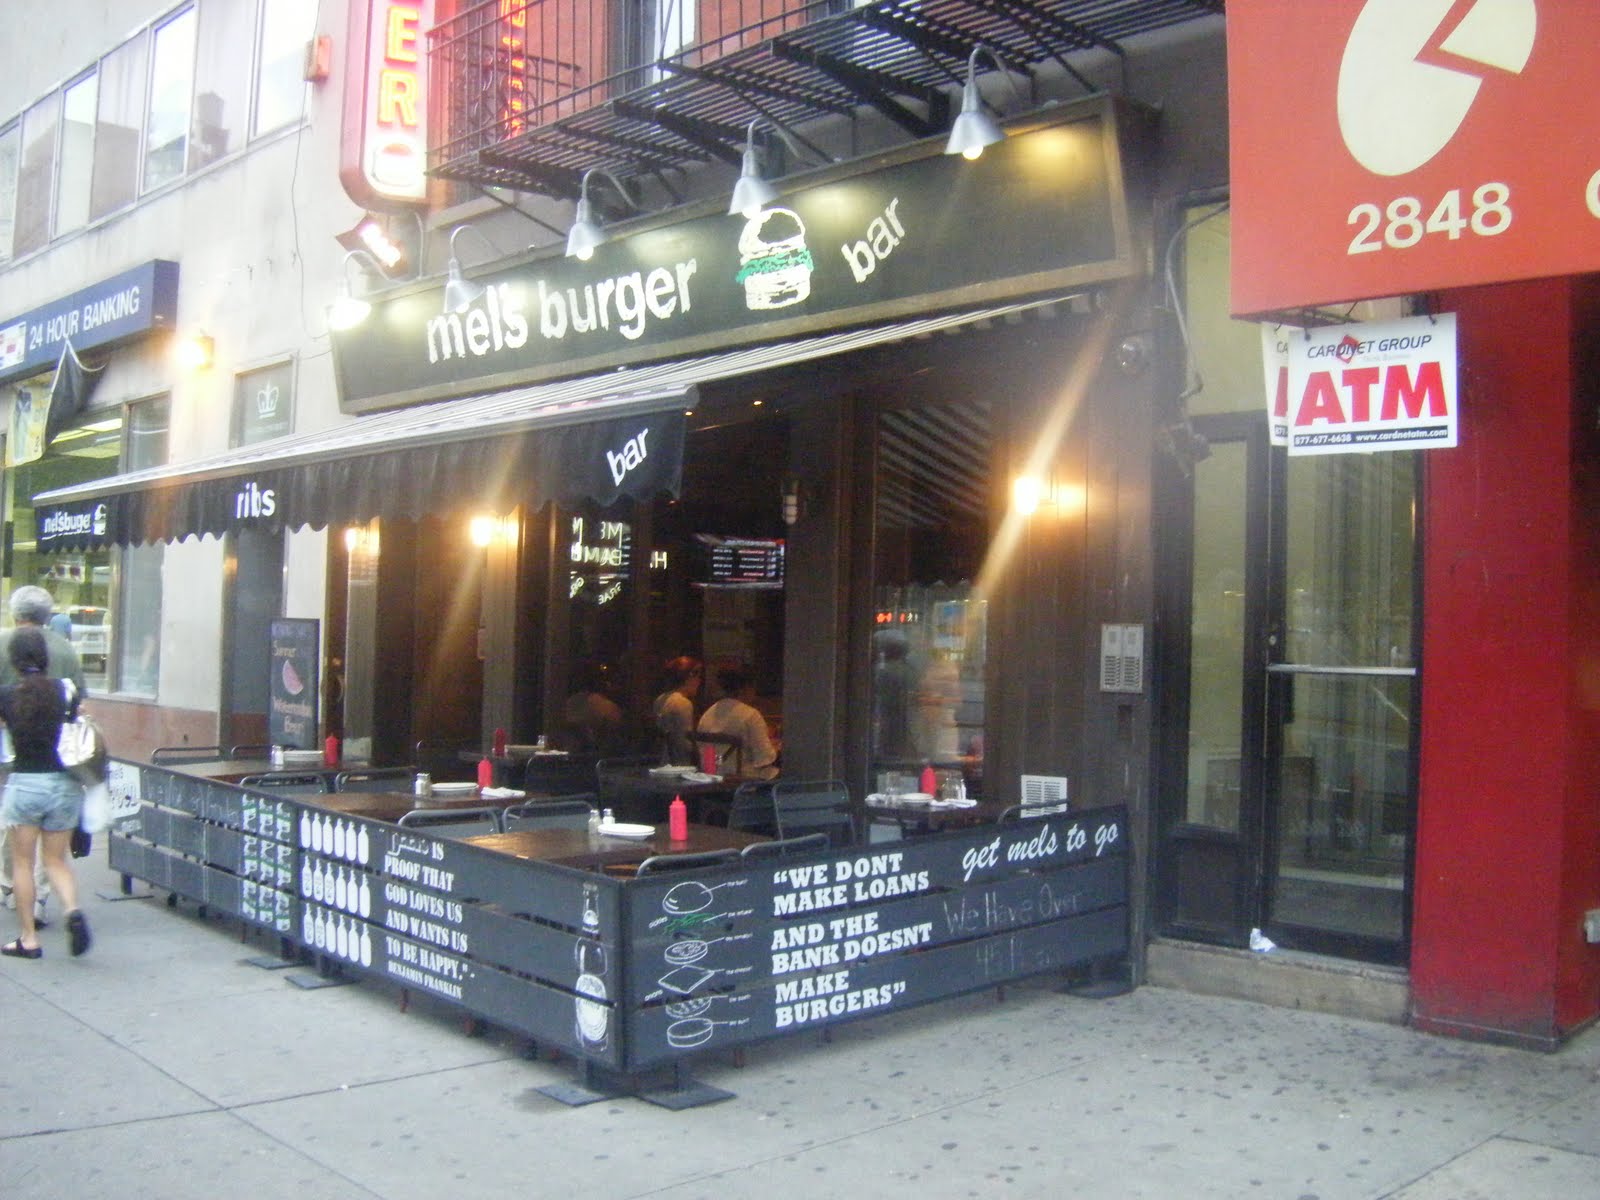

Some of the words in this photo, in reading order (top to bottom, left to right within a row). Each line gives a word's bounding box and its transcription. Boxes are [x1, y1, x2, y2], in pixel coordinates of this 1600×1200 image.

[841, 197, 906, 283] bar
[1347, 182, 1512, 255] 2848
[30, 326, 43, 350] 24
[47, 310, 79, 344] HOUR
[83, 286, 139, 330] BANKING
[538, 258, 697, 340] burger
[1378, 335, 1432, 351] GROUP
[1294, 361, 1448, 426] ATM
[606, 426, 649, 487] bar
[236, 482, 276, 518] ribs
[431, 841, 444, 861] IS
[836, 853, 903, 882] DONT
[962, 836, 1000, 882] get
[1007, 824, 1058, 862] mels
[1066, 823, 1087, 852] to
[1095, 823, 1118, 857] go
[384, 854, 421, 881] PROOF
[422, 866, 454, 892] THAT
[774, 884, 847, 917] MAKE
[854, 871, 929, 902] LOANS
[385, 883, 407, 906] GOD
[409, 889, 444, 919] LOVES
[446, 901, 463, 924] US
[386, 908, 409, 933] AND
[410, 916, 449, 948] WANTS
[451, 930, 468, 953] US
[386, 935, 401, 957] TO
[402, 941, 418, 964] BE
[771, 923, 825, 950] AND
[830, 911, 878, 940] THE
[772, 943, 839, 975] BANK
[844, 922, 932, 962] DOESNT
[388, 960, 423, 985] BENJAMIN
[424, 974, 462, 1000] FRANKLIN
[775, 970, 849, 1004] MAKE
